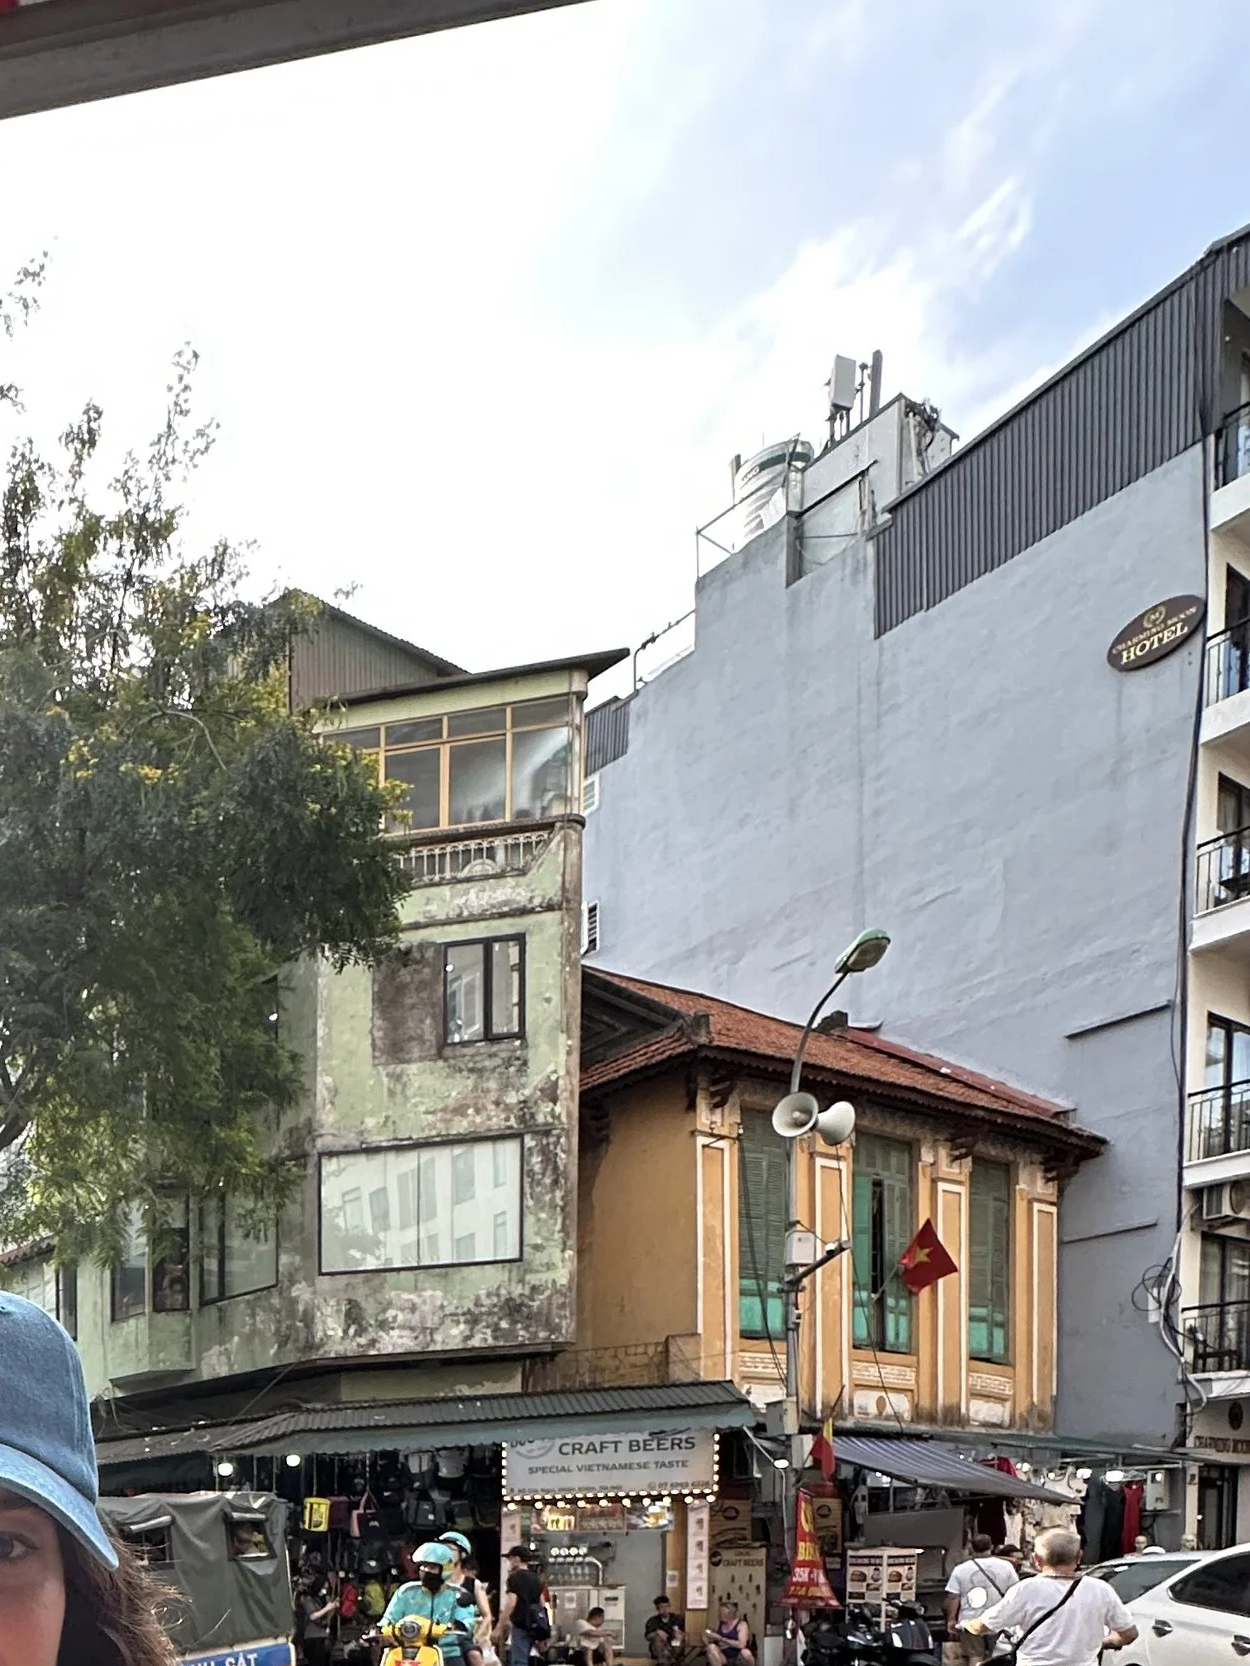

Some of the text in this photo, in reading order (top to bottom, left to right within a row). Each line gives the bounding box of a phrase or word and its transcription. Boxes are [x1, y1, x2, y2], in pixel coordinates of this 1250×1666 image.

[1120, 622, 1188, 665] HOTEL
[558, 1439, 623, 1456] CRAFT
[628, 1436, 696, 1453] BEERS
[528, 1459, 689, 1475] SPECIAL VIETNAMESE TASTE
